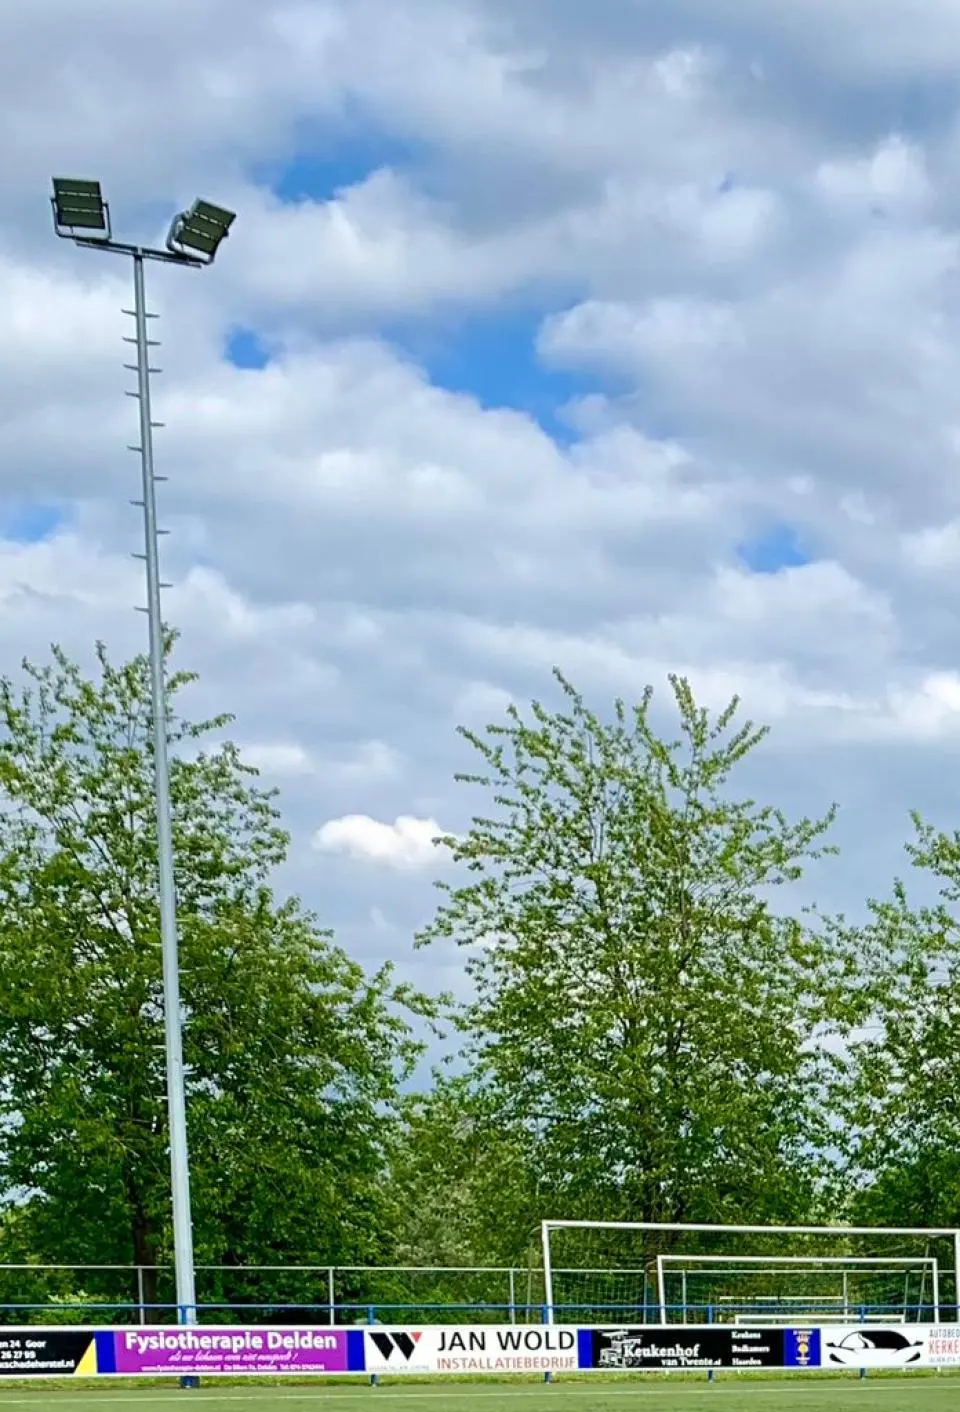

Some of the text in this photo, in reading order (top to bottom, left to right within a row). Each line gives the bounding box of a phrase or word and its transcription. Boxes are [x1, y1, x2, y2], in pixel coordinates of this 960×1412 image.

[125, 1331, 337, 1354] Fysiotherapie Delden
[437, 1330, 575, 1351] JAN WOLD
[623, 1343, 701, 1358] Keukenhof
[436, 1356, 575, 1369] INSTALLATIEBEDRIJF
